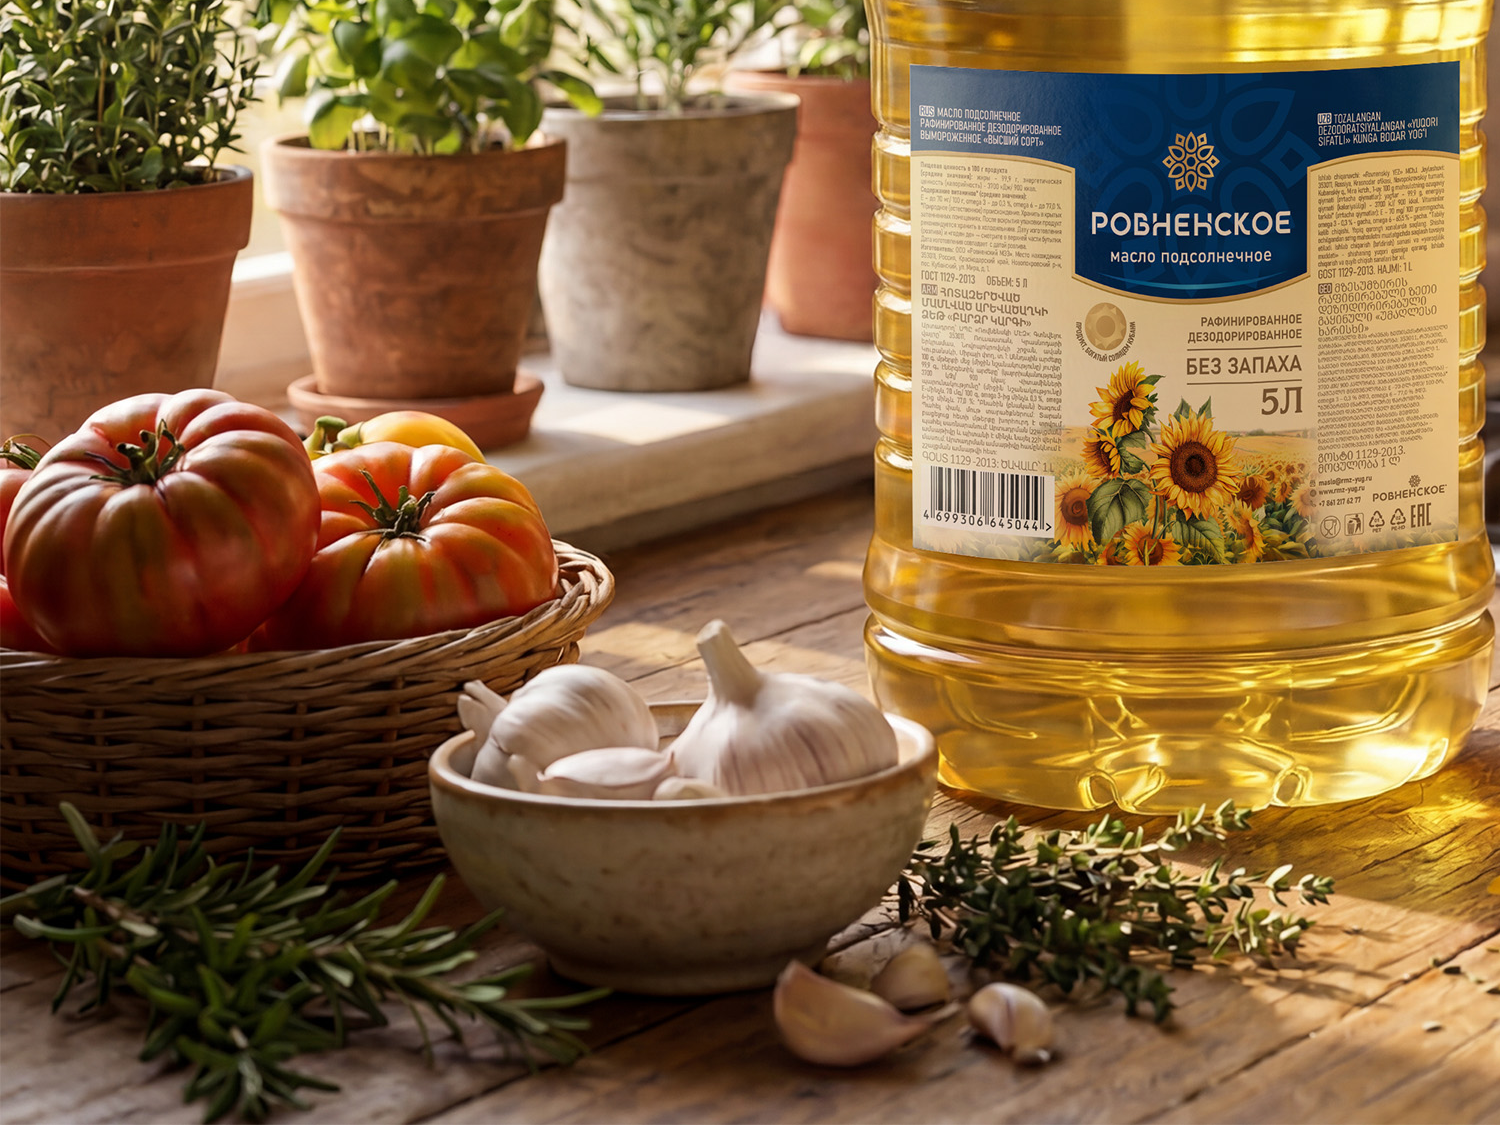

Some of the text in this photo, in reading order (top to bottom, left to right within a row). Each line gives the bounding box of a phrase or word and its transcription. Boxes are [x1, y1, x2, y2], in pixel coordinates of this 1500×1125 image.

[920, 105, 1021, 122] RUS МАСЛО ПОДСОЛНЕЧНОЕ
[1317, 112, 1381, 125] UZB TOZALANGAN
[920, 118, 1062, 136] РАФИНИРОВАННОЕ ДЕЗОДОРИРОВАННОЕ
[1318, 117, 1438, 135] DEZODORATSIYALANGAN «YUQORI
[920, 129, 1044, 147] ВЫМОРОЖЕННОЕ «ВЫСШИЙ СОРТ»
[1318, 135, 1350, 146] SIFATLI»
[1353, 132, 1378, 144] KUNGA
[1380, 131, 1406, 143] BOQAR
[1091, 211, 1291, 236] РОВНЕНСКОЕ
[1110, 250, 1272, 265] масло подсолнечное
[1318, 262, 1413, 279] GOST 1129-2013. HAJMI: 1 L
[921, 270, 1028, 288] ГОСТ 1129-2013 ОБЪЕМ: 5 Л
[921, 284, 938, 296] ARM
[1318, 283, 1332, 295] GEO
[1201, 314, 1302, 327] РАФИНИРОВАННОЕ
[1187, 329, 1302, 344] ДЕЗОДОРИРОВАННОЕ
[1187, 355, 1302, 375] БЕЗ ЗАПАХА
[1261, 387, 1303, 415] 5Л
[1355, 445, 1406, 460] 1129-2013.
[951, 454, 971, 466] 1129
[1043, 463, 1047, 472] 1
[1381, 458, 1386, 468] 1
[1319, 475, 1372, 487] maslo@rmz-yug.ru
[1319, 485, 1365, 496] www.rmz-yug.ru
[1318, 496, 1361, 507] +7 861 217 62 77
[936, 511, 984, 527] 699306
[990, 518, 1038, 531] 645044
